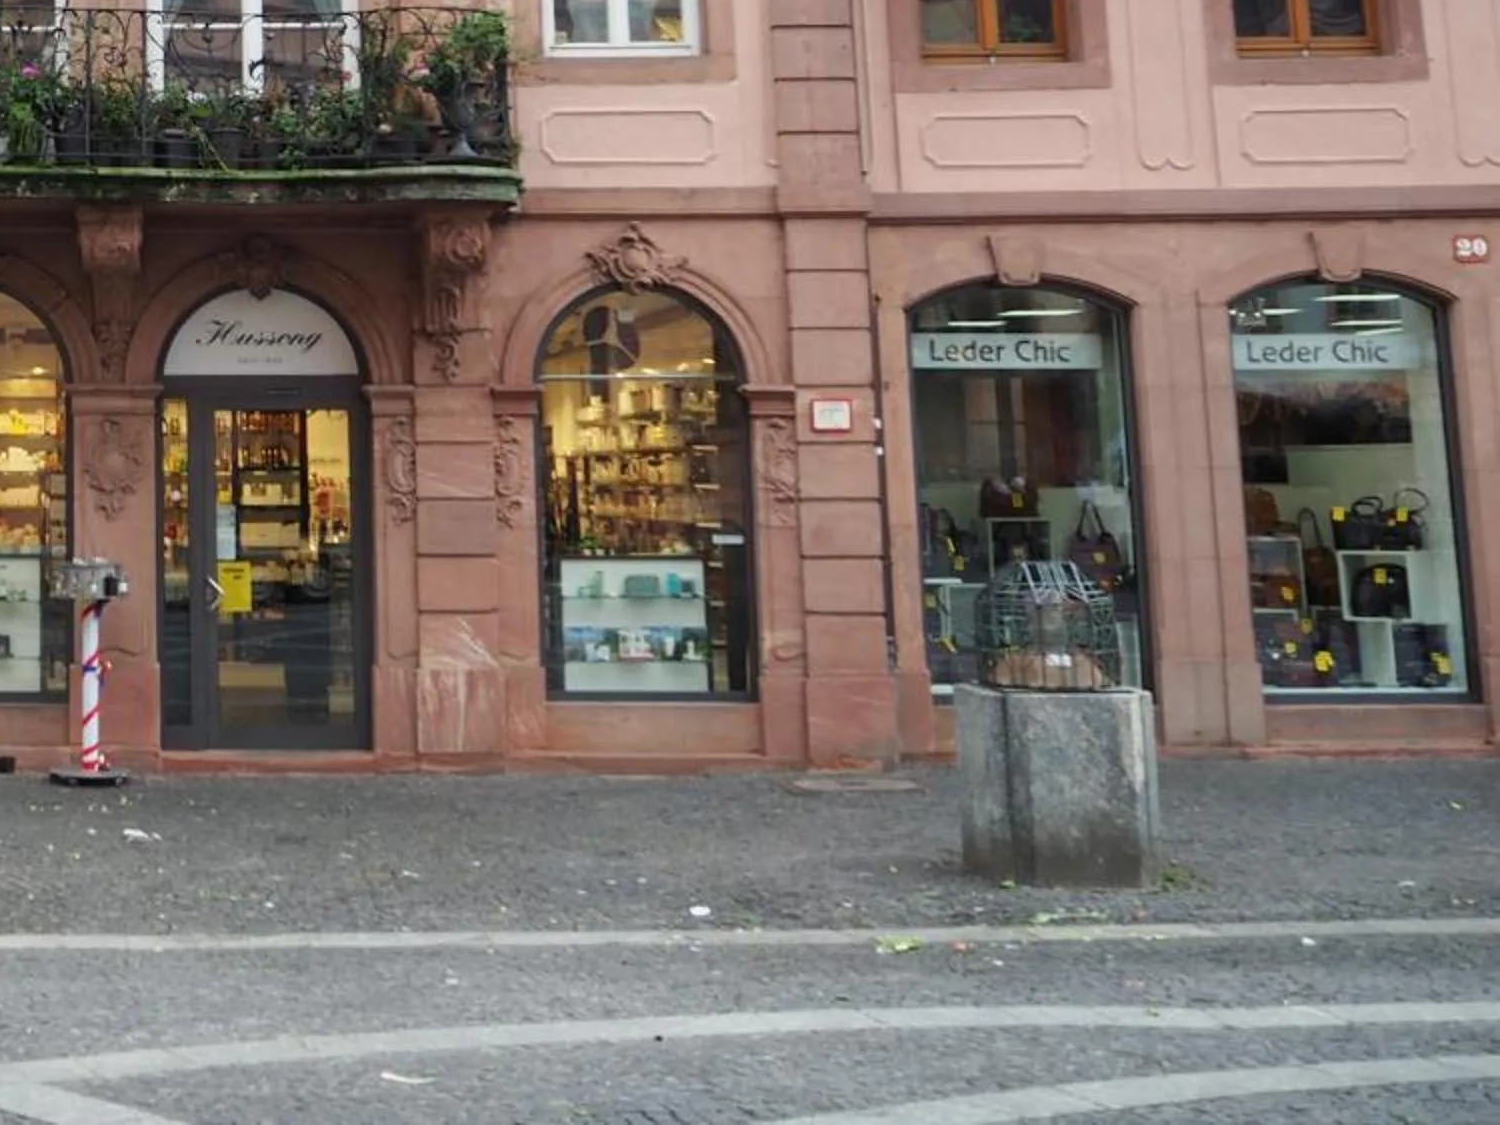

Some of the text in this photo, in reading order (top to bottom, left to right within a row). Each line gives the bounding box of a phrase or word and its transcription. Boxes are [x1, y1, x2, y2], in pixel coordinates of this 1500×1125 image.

[1456, 237, 1488, 256] 20
[195, 319, 323, 353] Hussong
[928, 339, 1072, 363] Leder Chic
[1245, 339, 1389, 364] Leder Chic
